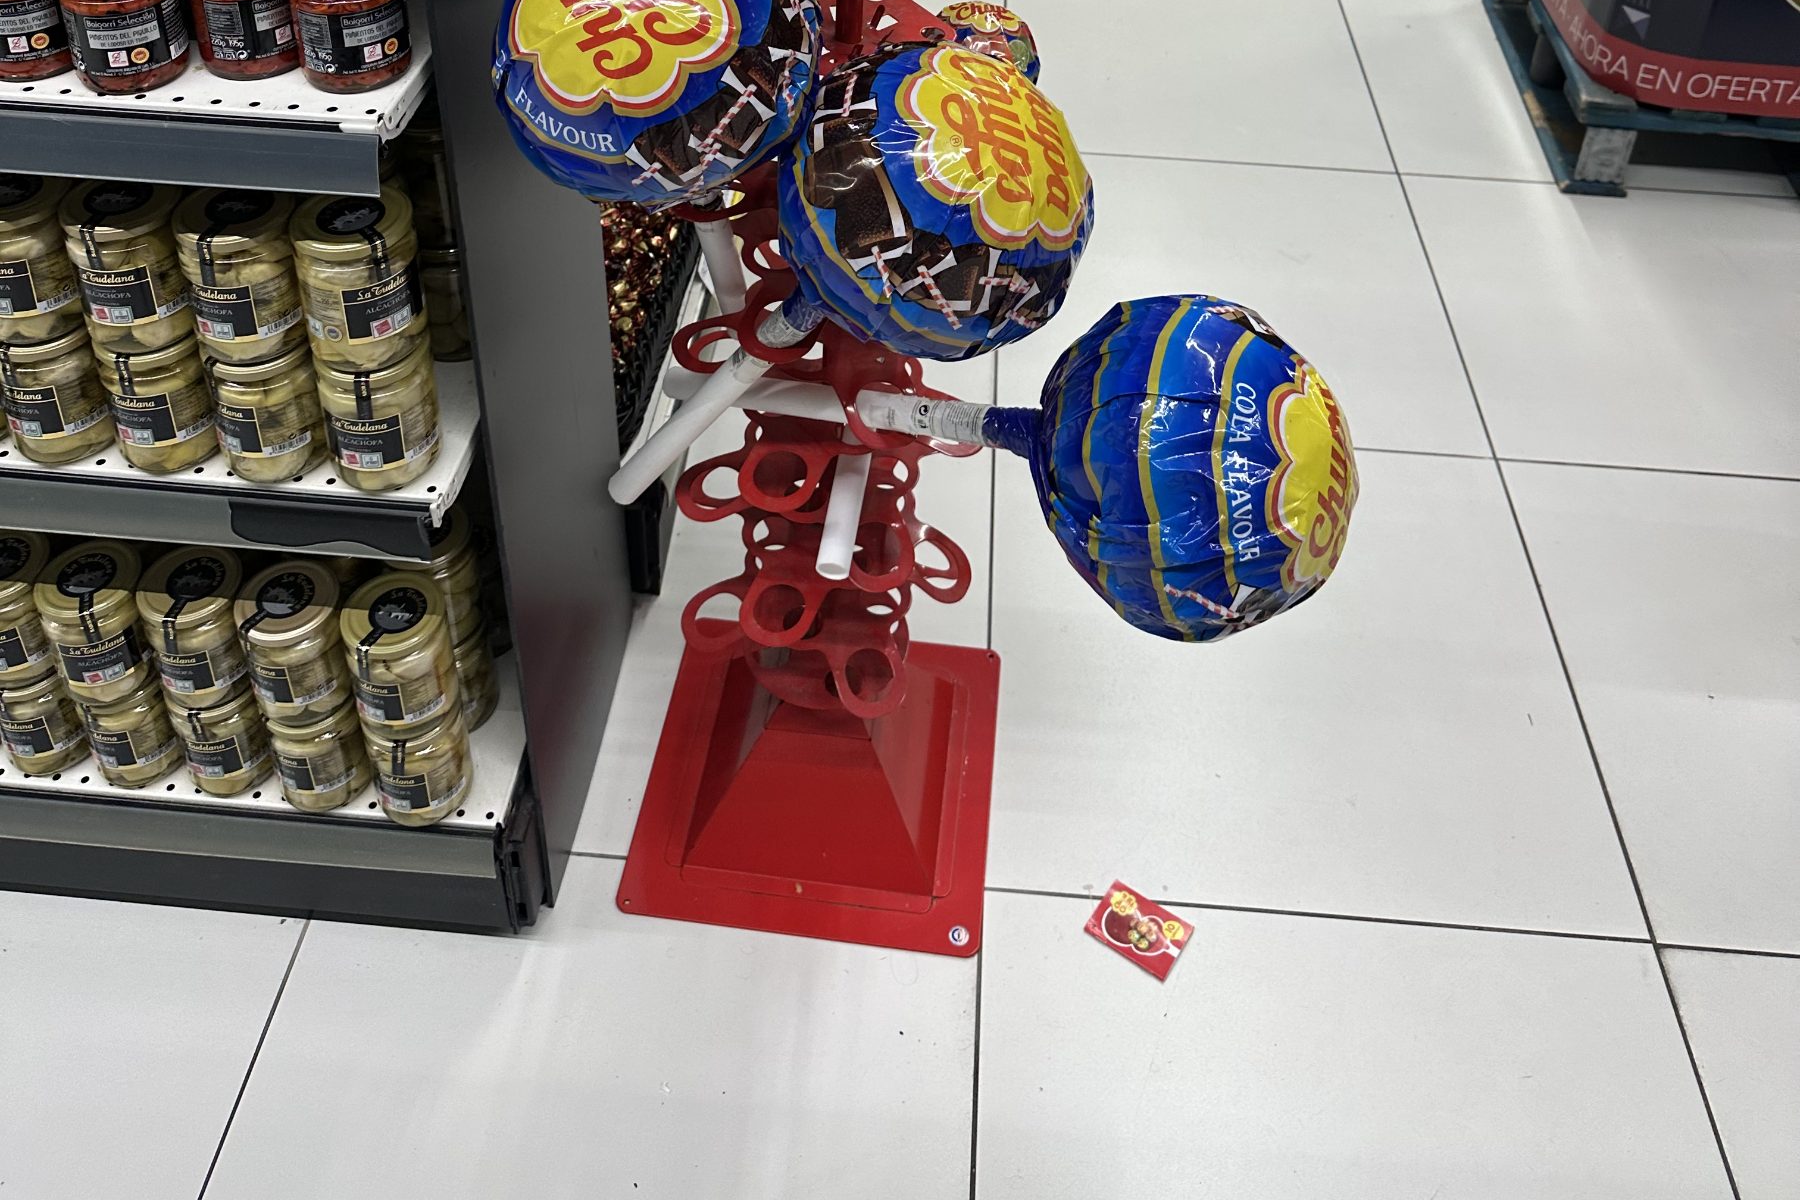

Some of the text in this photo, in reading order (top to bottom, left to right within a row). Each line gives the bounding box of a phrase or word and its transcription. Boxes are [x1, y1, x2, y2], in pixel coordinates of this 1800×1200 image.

[86, 11, 155, 30] Baigorri Selección
[89, 24, 158, 41] PIMIENTOS DEL PIQUILLO
[343, 15, 374, 26] Baigorri
[1568, 15, 1630, 81] AHORA
[1635, 63, 1684, 94] EN
[513, 86, 617, 153] FLAVOUR
[941, 54, 1034, 208] Chups
[87, 271, 135, 284] Tudelana
[357, 275, 408, 301] La Tudela
[365, 288, 411, 316] ALCACHOFA
[343, 418, 388, 432] Tudelana
[1228, 382, 1257, 443] COLA
[1226, 450, 1260, 562] FLAVOUR
[69, 635, 125, 656] La Tudelana
